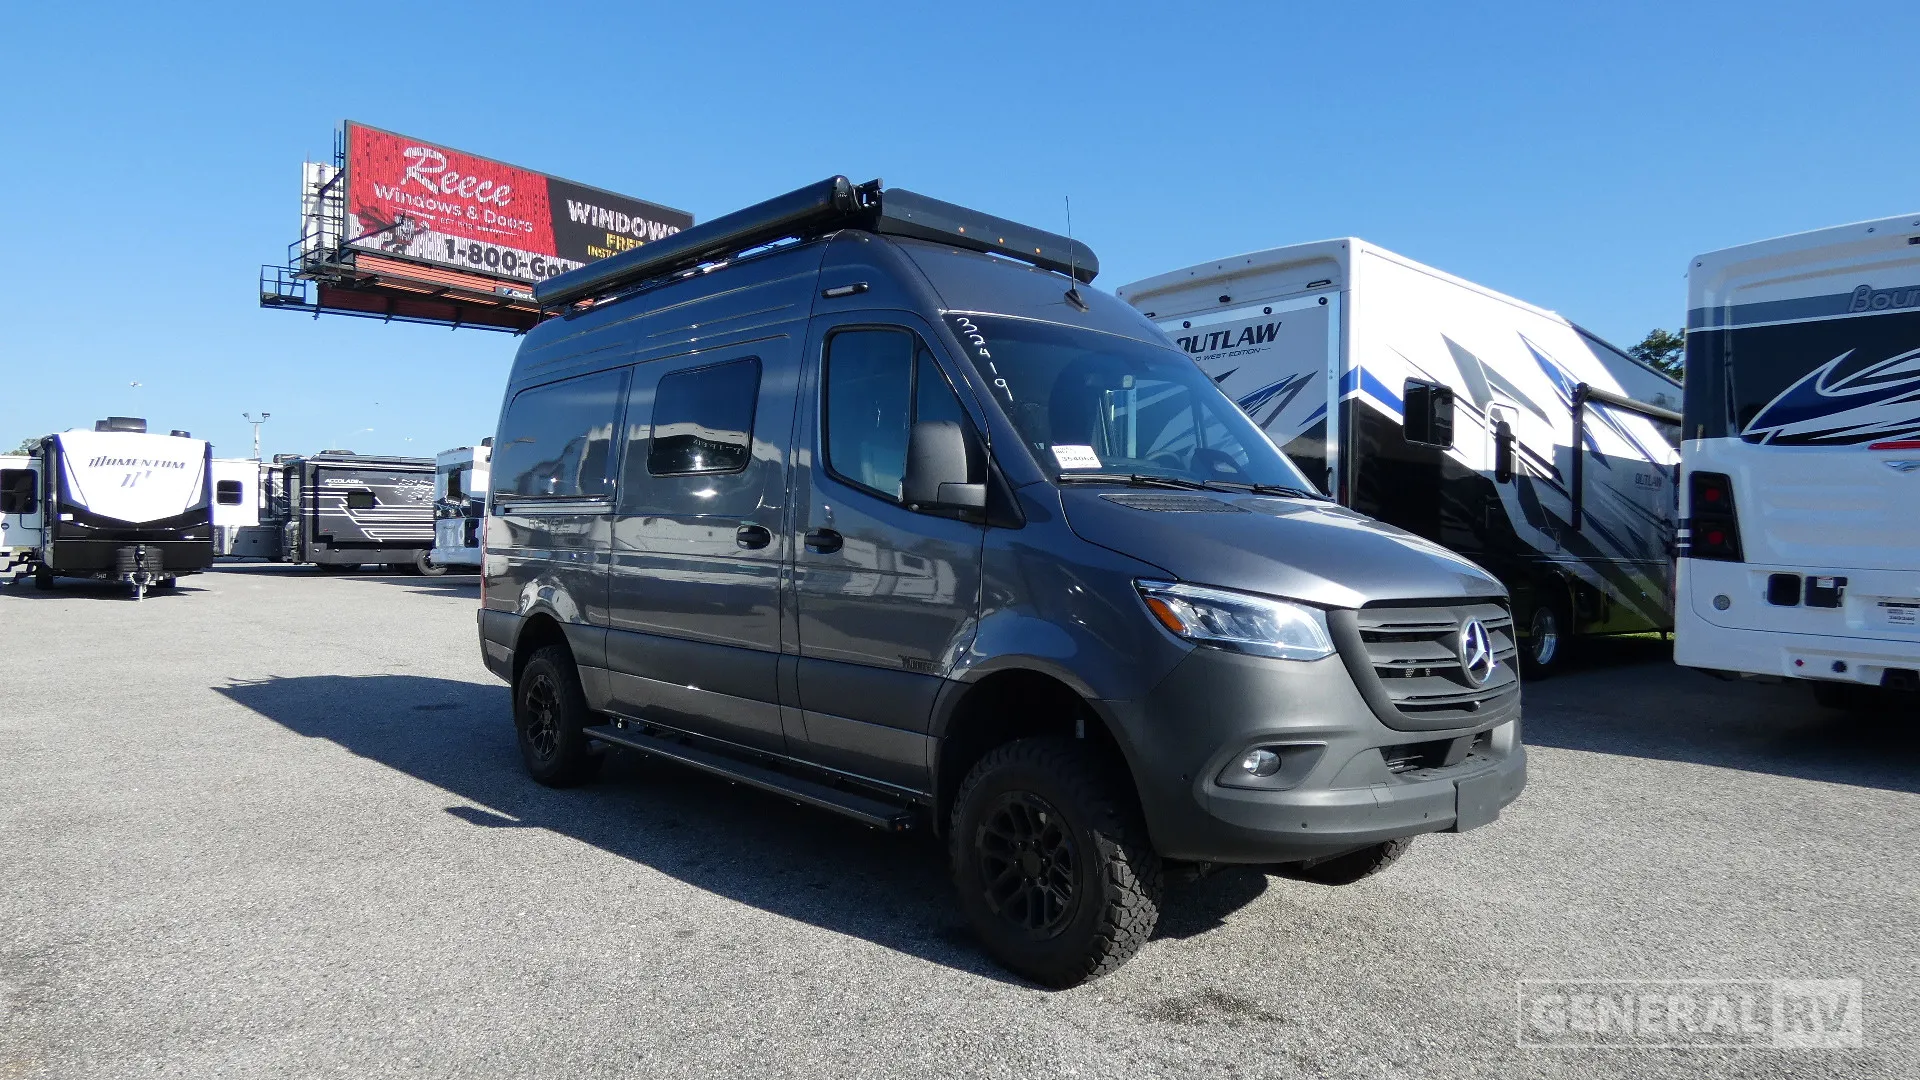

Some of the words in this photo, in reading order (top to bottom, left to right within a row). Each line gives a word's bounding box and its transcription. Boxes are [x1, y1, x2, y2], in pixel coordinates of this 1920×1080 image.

[401, 147, 512, 206] Reece
[373, 182, 462, 216] Windows
[466, 205, 479, 220] &
[484, 209, 533, 233] Doors
[512, 290, 529, 299] Clear
[1176, 321, 1282, 353] OUTLAW
[1204, 352, 1227, 361] WEST
[1229, 347, 1261, 358] EDITION
[957, 317, 1013, 401] 32419
